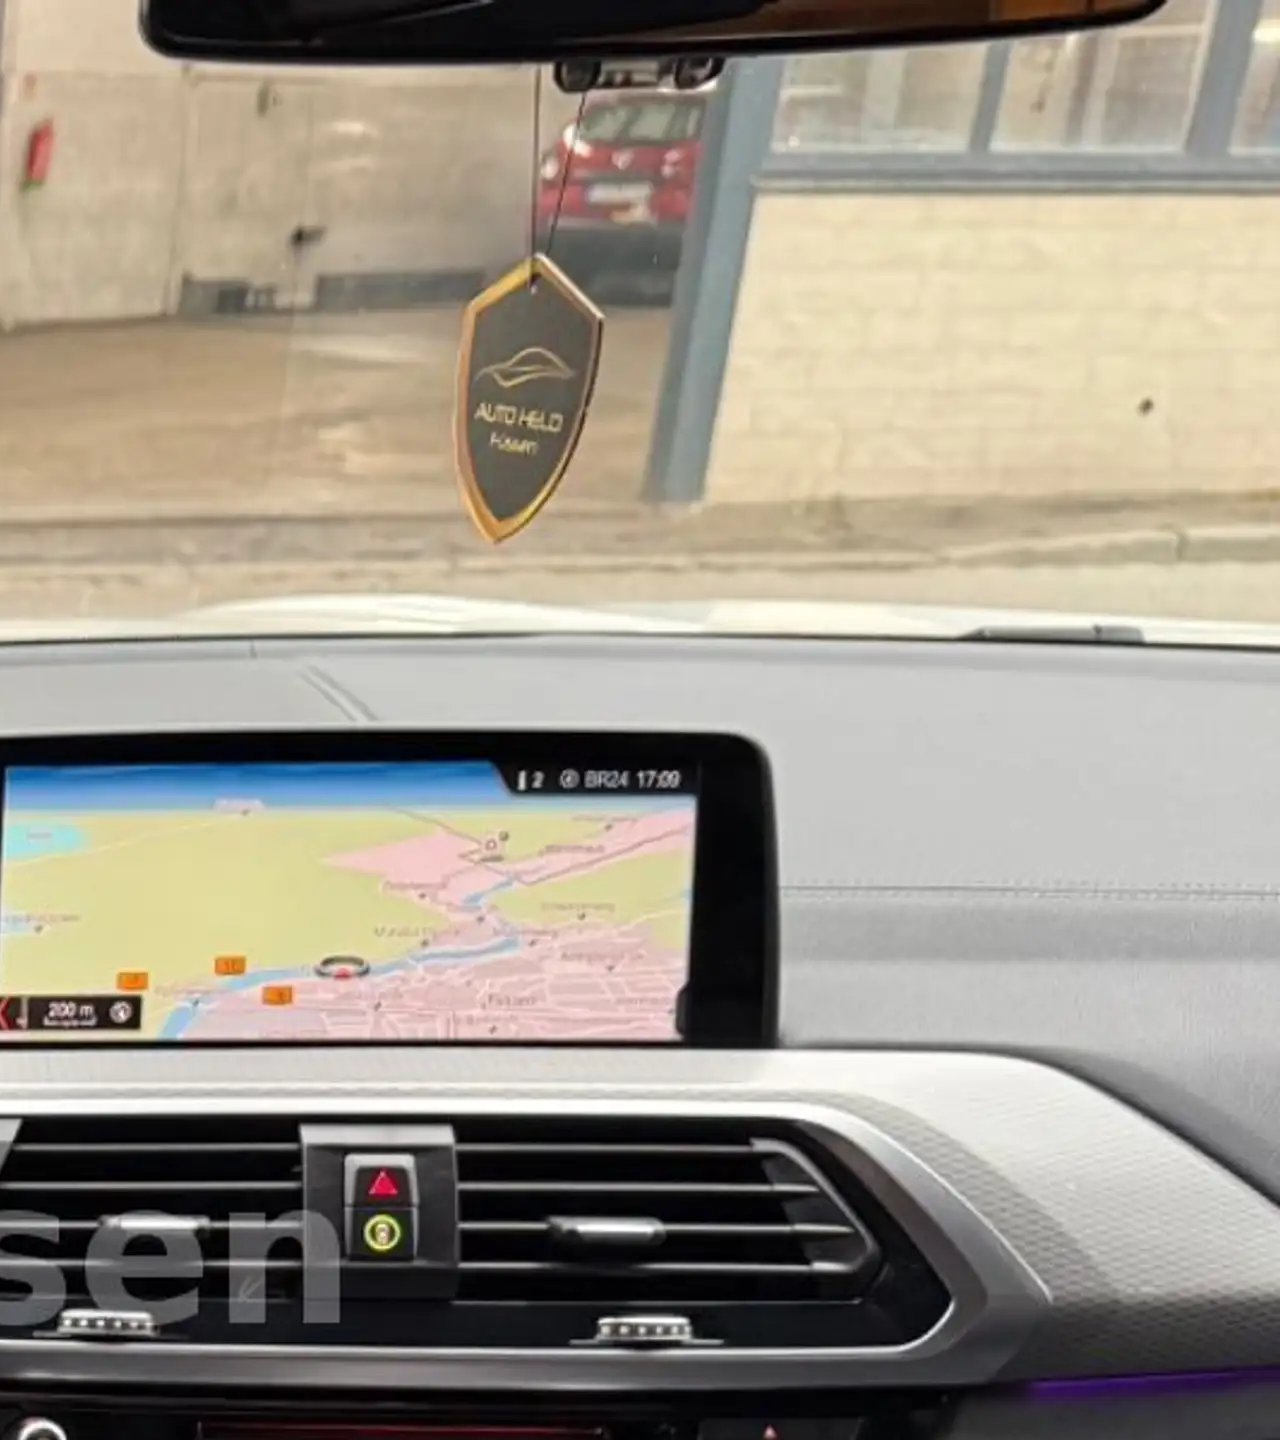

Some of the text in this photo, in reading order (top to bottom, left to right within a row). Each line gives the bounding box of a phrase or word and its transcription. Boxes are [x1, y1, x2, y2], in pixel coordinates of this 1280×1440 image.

[474, 402, 565, 433] AUTO HELD
[584, 771, 629, 788] BR24
[638, 770, 682, 788] 17:09
[49, 1002, 76, 1017] 200
